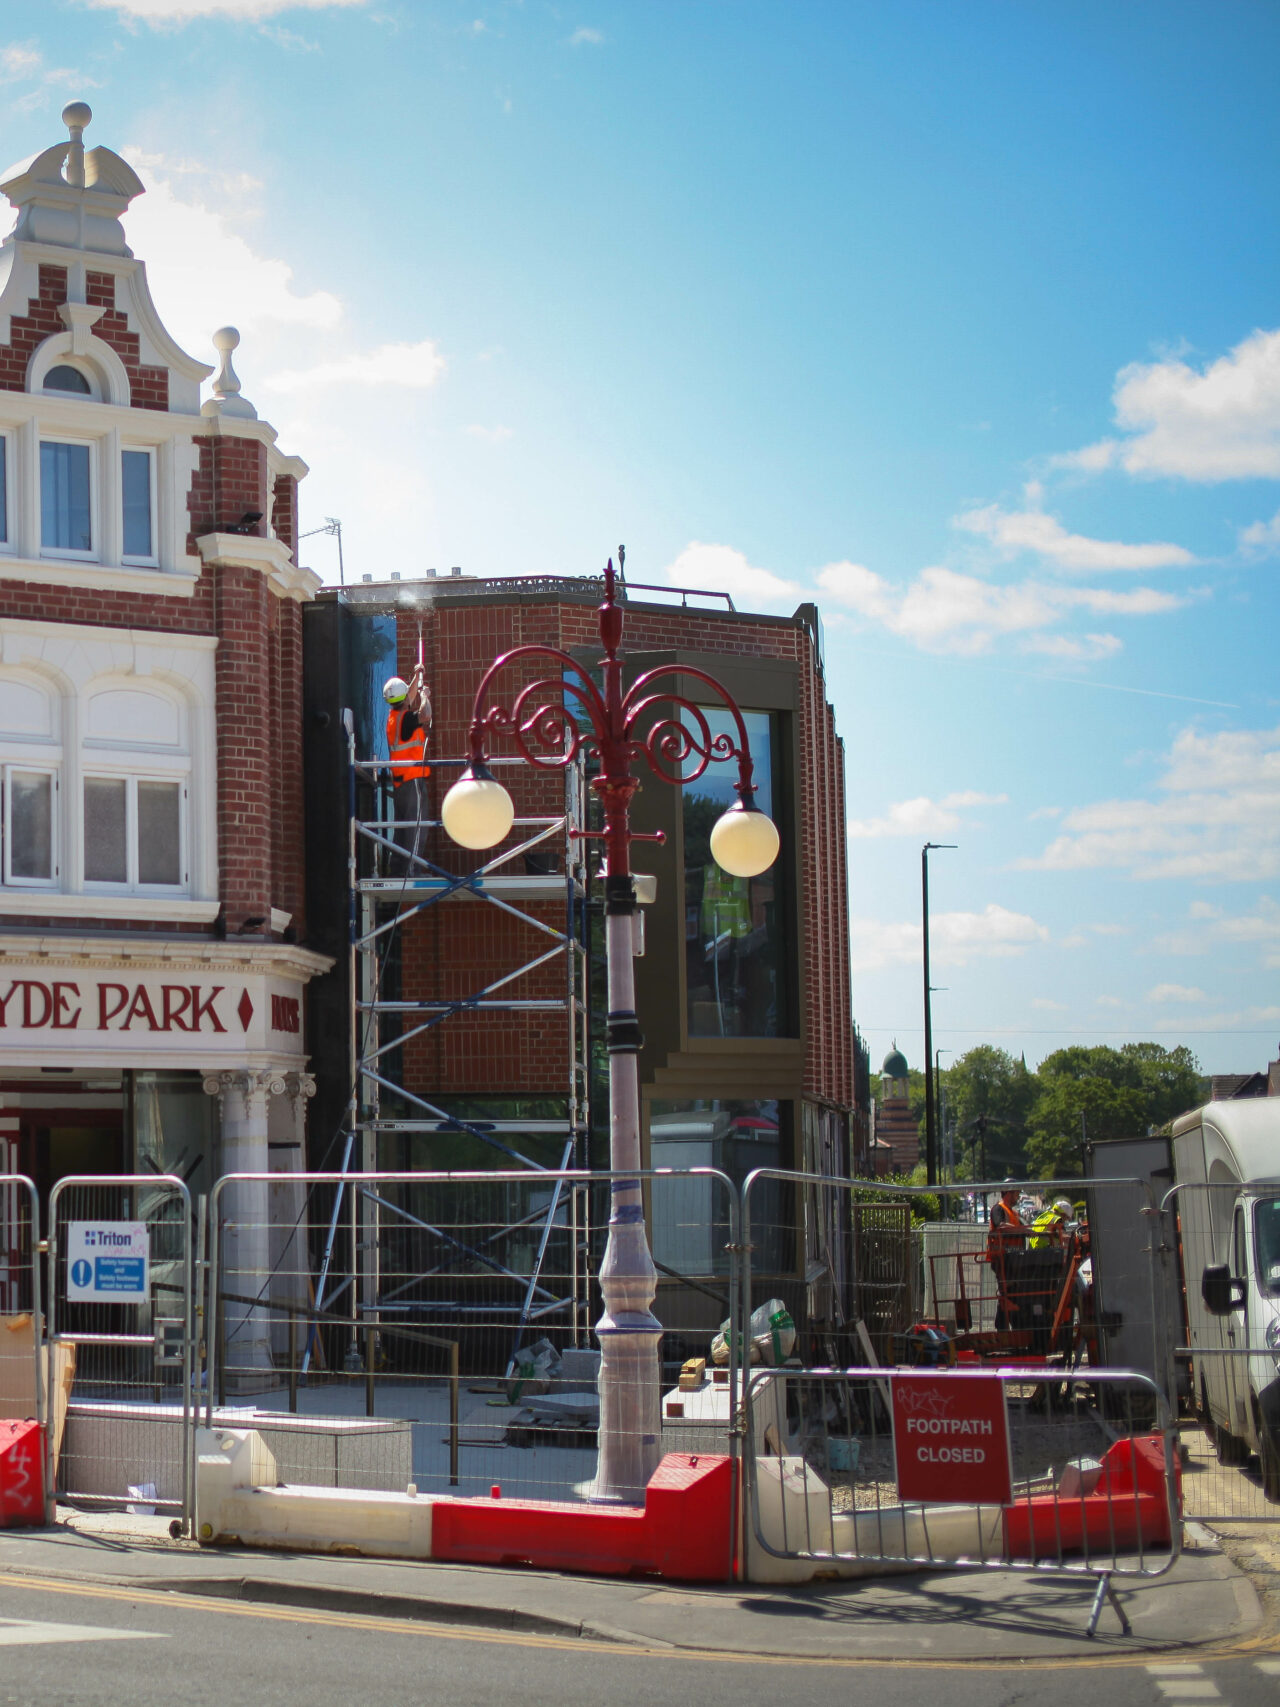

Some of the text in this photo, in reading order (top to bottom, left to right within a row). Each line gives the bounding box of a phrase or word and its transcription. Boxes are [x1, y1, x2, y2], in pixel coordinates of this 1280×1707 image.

[97, 982, 229, 1034] PARK
[97, 1231, 132, 1246] Triton
[906, 1418, 993, 1435] FOOTPATH
[917, 1447, 986, 1463] CLOSED
